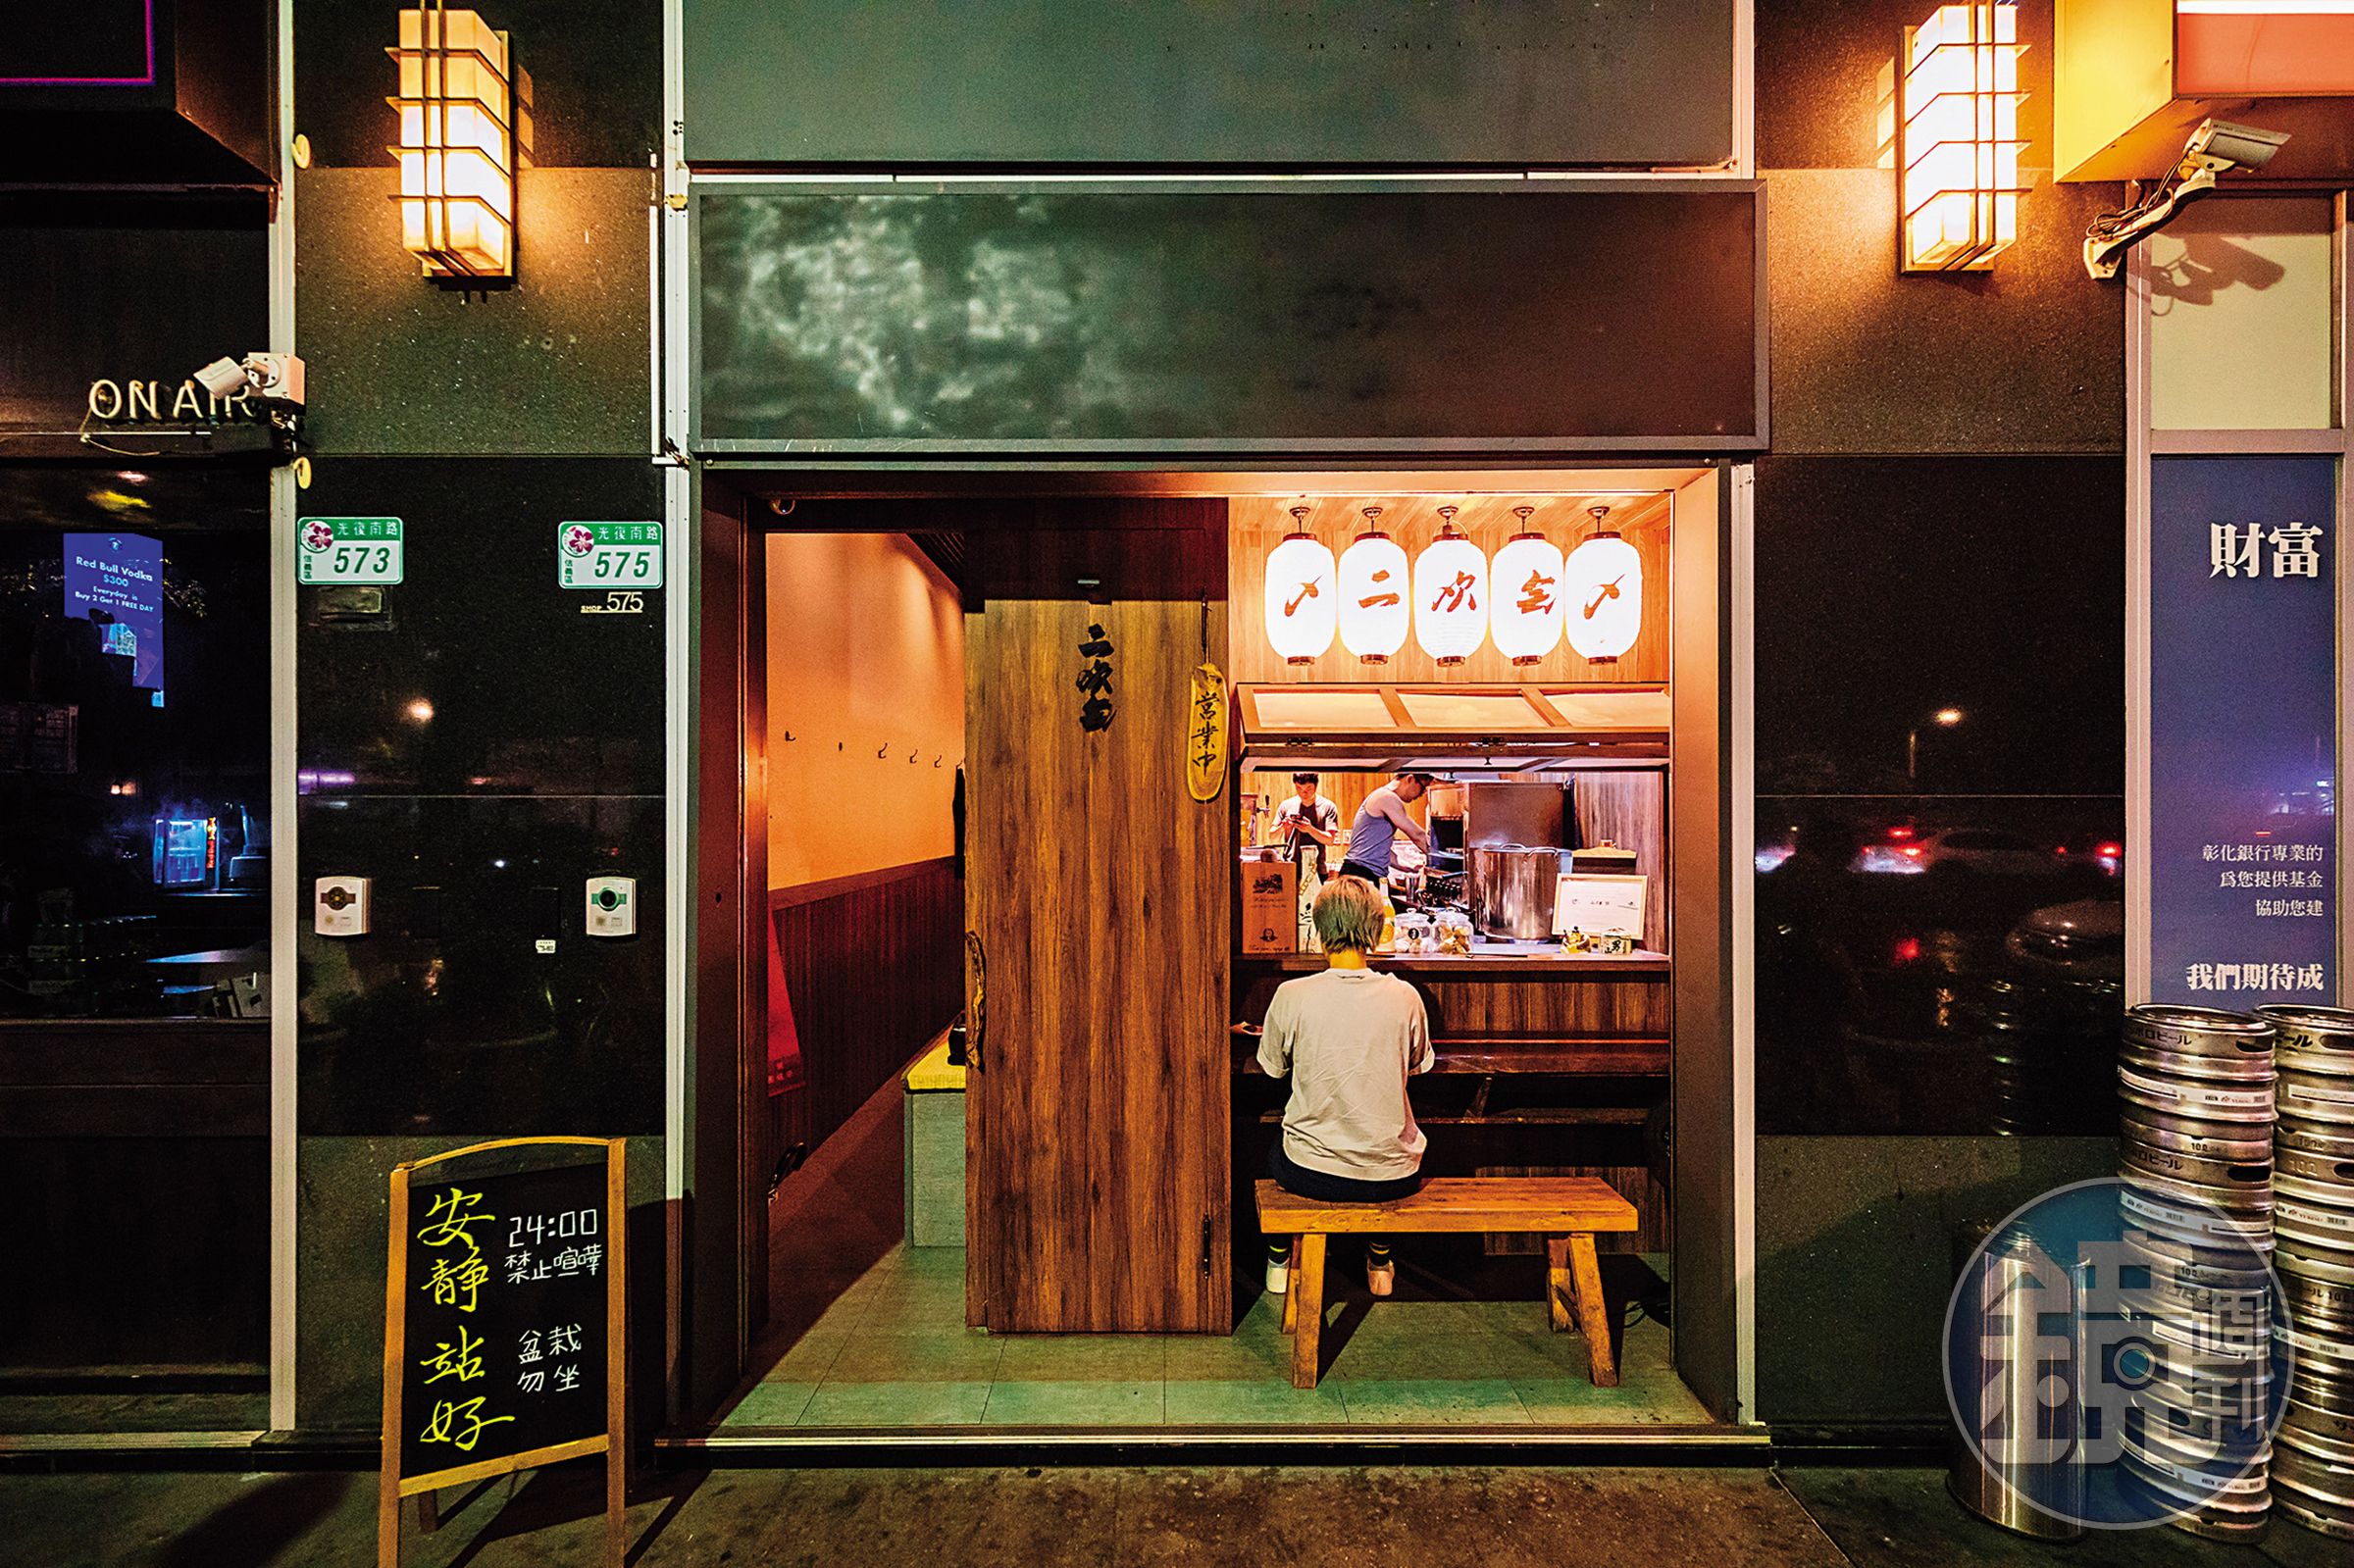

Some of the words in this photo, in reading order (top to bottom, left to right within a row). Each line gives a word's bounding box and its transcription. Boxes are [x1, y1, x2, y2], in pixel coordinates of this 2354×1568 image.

[89, 379, 162, 419] ON
[337, 521, 398, 536] 光復南路
[598, 526, 658, 540] 光復南路
[333, 547, 390, 574] 573
[2209, 522, 2324, 579] 財富
[76, 556, 96, 569] Red
[100, 562, 119, 574] Bull
[121, 567, 153, 582] Vodka
[594, 552, 650, 579] 575
[122, 600, 138, 610] FREE
[607, 591, 643, 612] 575
[2202, 843, 2324, 862] 彰化銀行專業的
[2255, 898, 2324, 917] 協助您建
[2185, 963, 2325, 991] 我們期待成
[507, 1209, 597, 1247] 24:00
[503, 1243, 603, 1284] 禁止喧嘩
[517, 1323, 583, 1364] 盆栽
[517, 1364, 581, 1393] 勿坐
